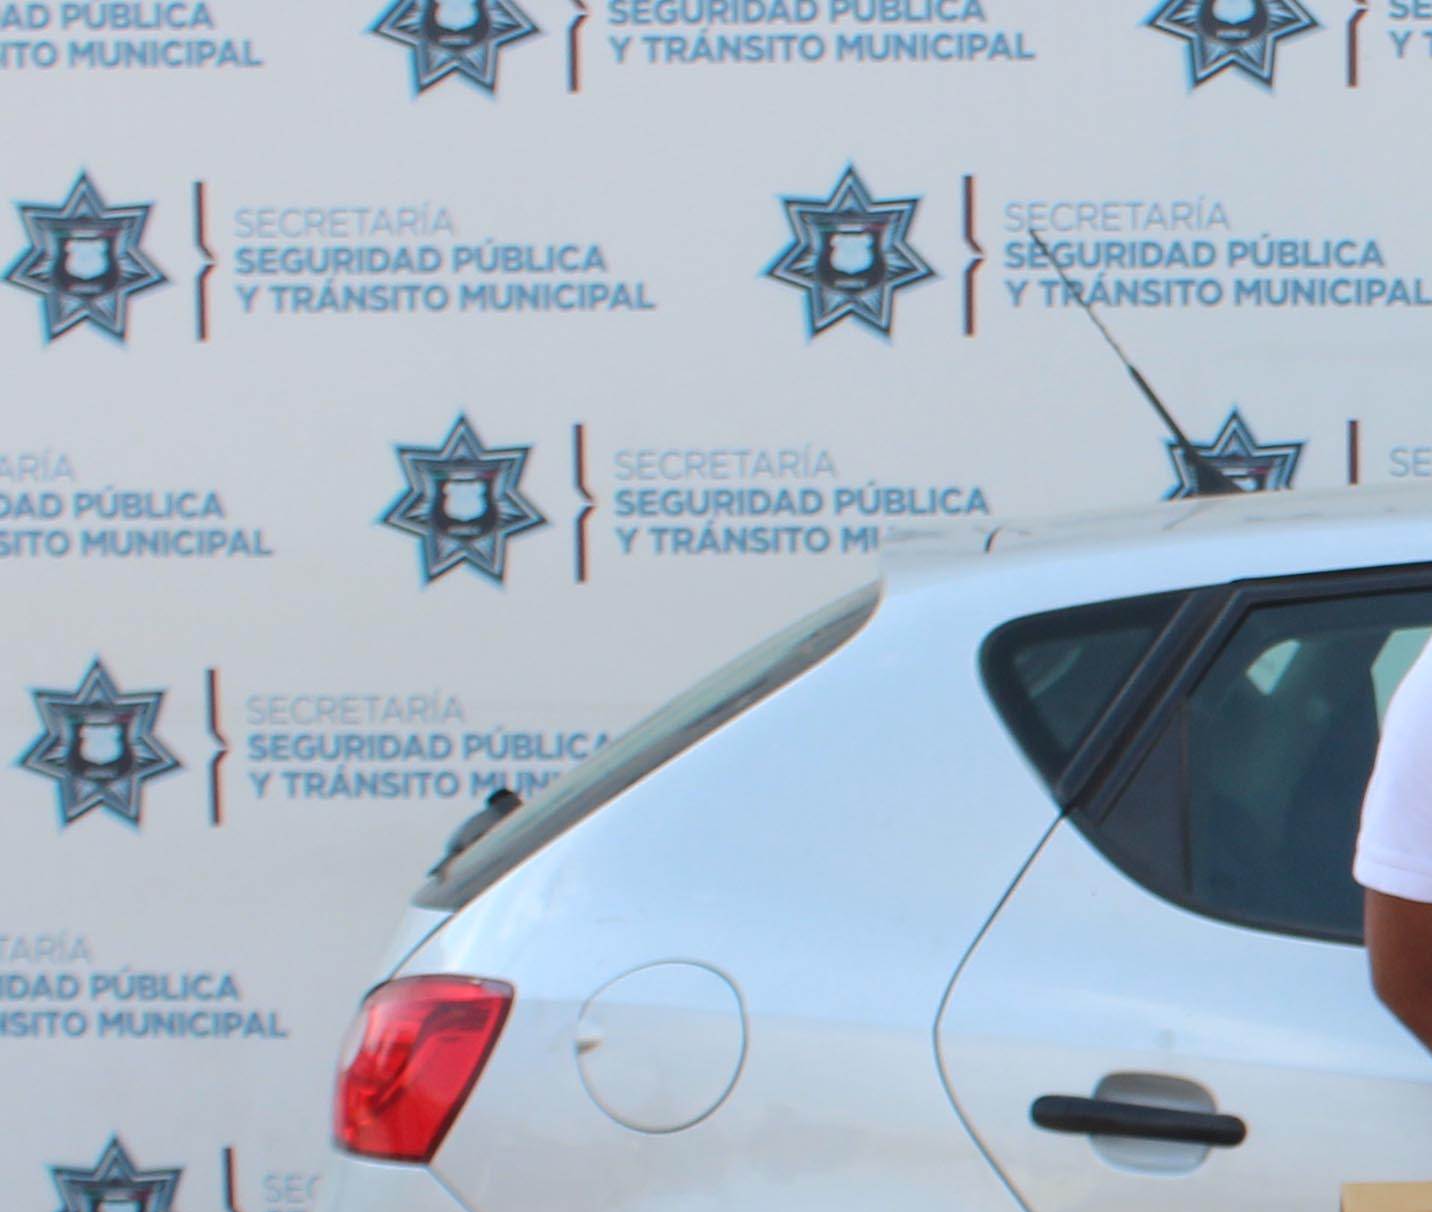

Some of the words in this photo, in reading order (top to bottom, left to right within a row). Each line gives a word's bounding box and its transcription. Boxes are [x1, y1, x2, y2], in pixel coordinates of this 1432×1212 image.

[607, 0, 818, 24] SEGURIDAD
[67, 39, 263, 67] MUNICIPAL
[608, 35, 632, 62] Y
[640, 25, 826, 61] TRÁNSITO
[835, 32, 1035, 60] MUNICIPAL
[1388, 29, 1413, 57] Y
[235, 202, 452, 237] SECRETARÍA
[1005, 196, 1229, 231] SECRETARÍA
[234, 246, 442, 274] SEGURIDAD
[451, 236, 606, 272] PÚBLICA
[1004, 240, 1217, 268] SEGURIDAD
[1226, 231, 1384, 267] PÚBLICA
[235, 284, 259, 312] Y
[267, 275, 449, 311] TRÁNSITO
[458, 282, 656, 310] MUNICIPAL
[1004, 278, 1029, 306] Y
[1037, 269, 1223, 306] TRÁNSITO
[614, 444, 835, 479] SECRETARÍA
[72, 483, 224, 519] PÚBLICA
[614, 488, 824, 516] SEGURIDAD
[832, 479, 990, 515] PÚBLICA
[79, 529, 273, 556] MUNICIPAL
[614, 526, 638, 554] Y
[647, 517, 831, 553] TRÁNSITO
[246, 691, 464, 724] SECRETARÍA
[247, 733, 452, 761] SEGURIDAD
[248, 771, 271, 798] Y
[280, 762, 461, 798] TRÁNSITO
[89, 965, 239, 1001] PÚBLICA
[96, 1011, 288, 1038] MUNICIPAL
